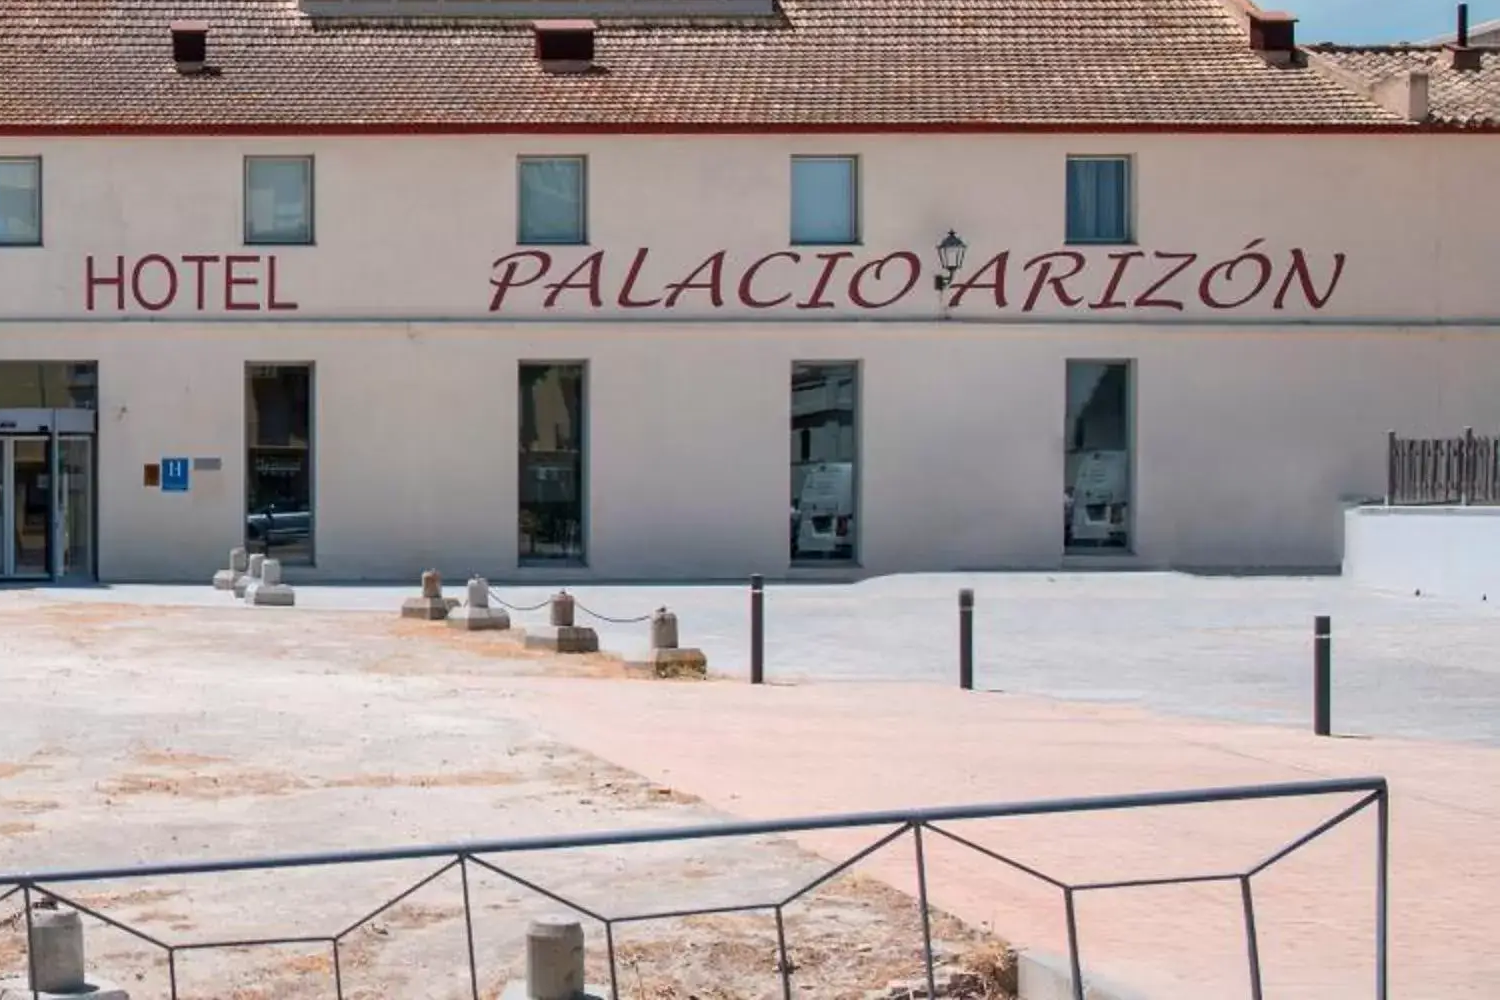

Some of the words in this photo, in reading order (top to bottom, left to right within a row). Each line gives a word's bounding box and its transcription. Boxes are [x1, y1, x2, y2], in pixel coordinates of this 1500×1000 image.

[86, 253, 298, 312] HOTEL
[488, 247, 922, 313] PALACIO
[950, 237, 1346, 313] ARIZÓN
[168, 461, 181, 477] H
